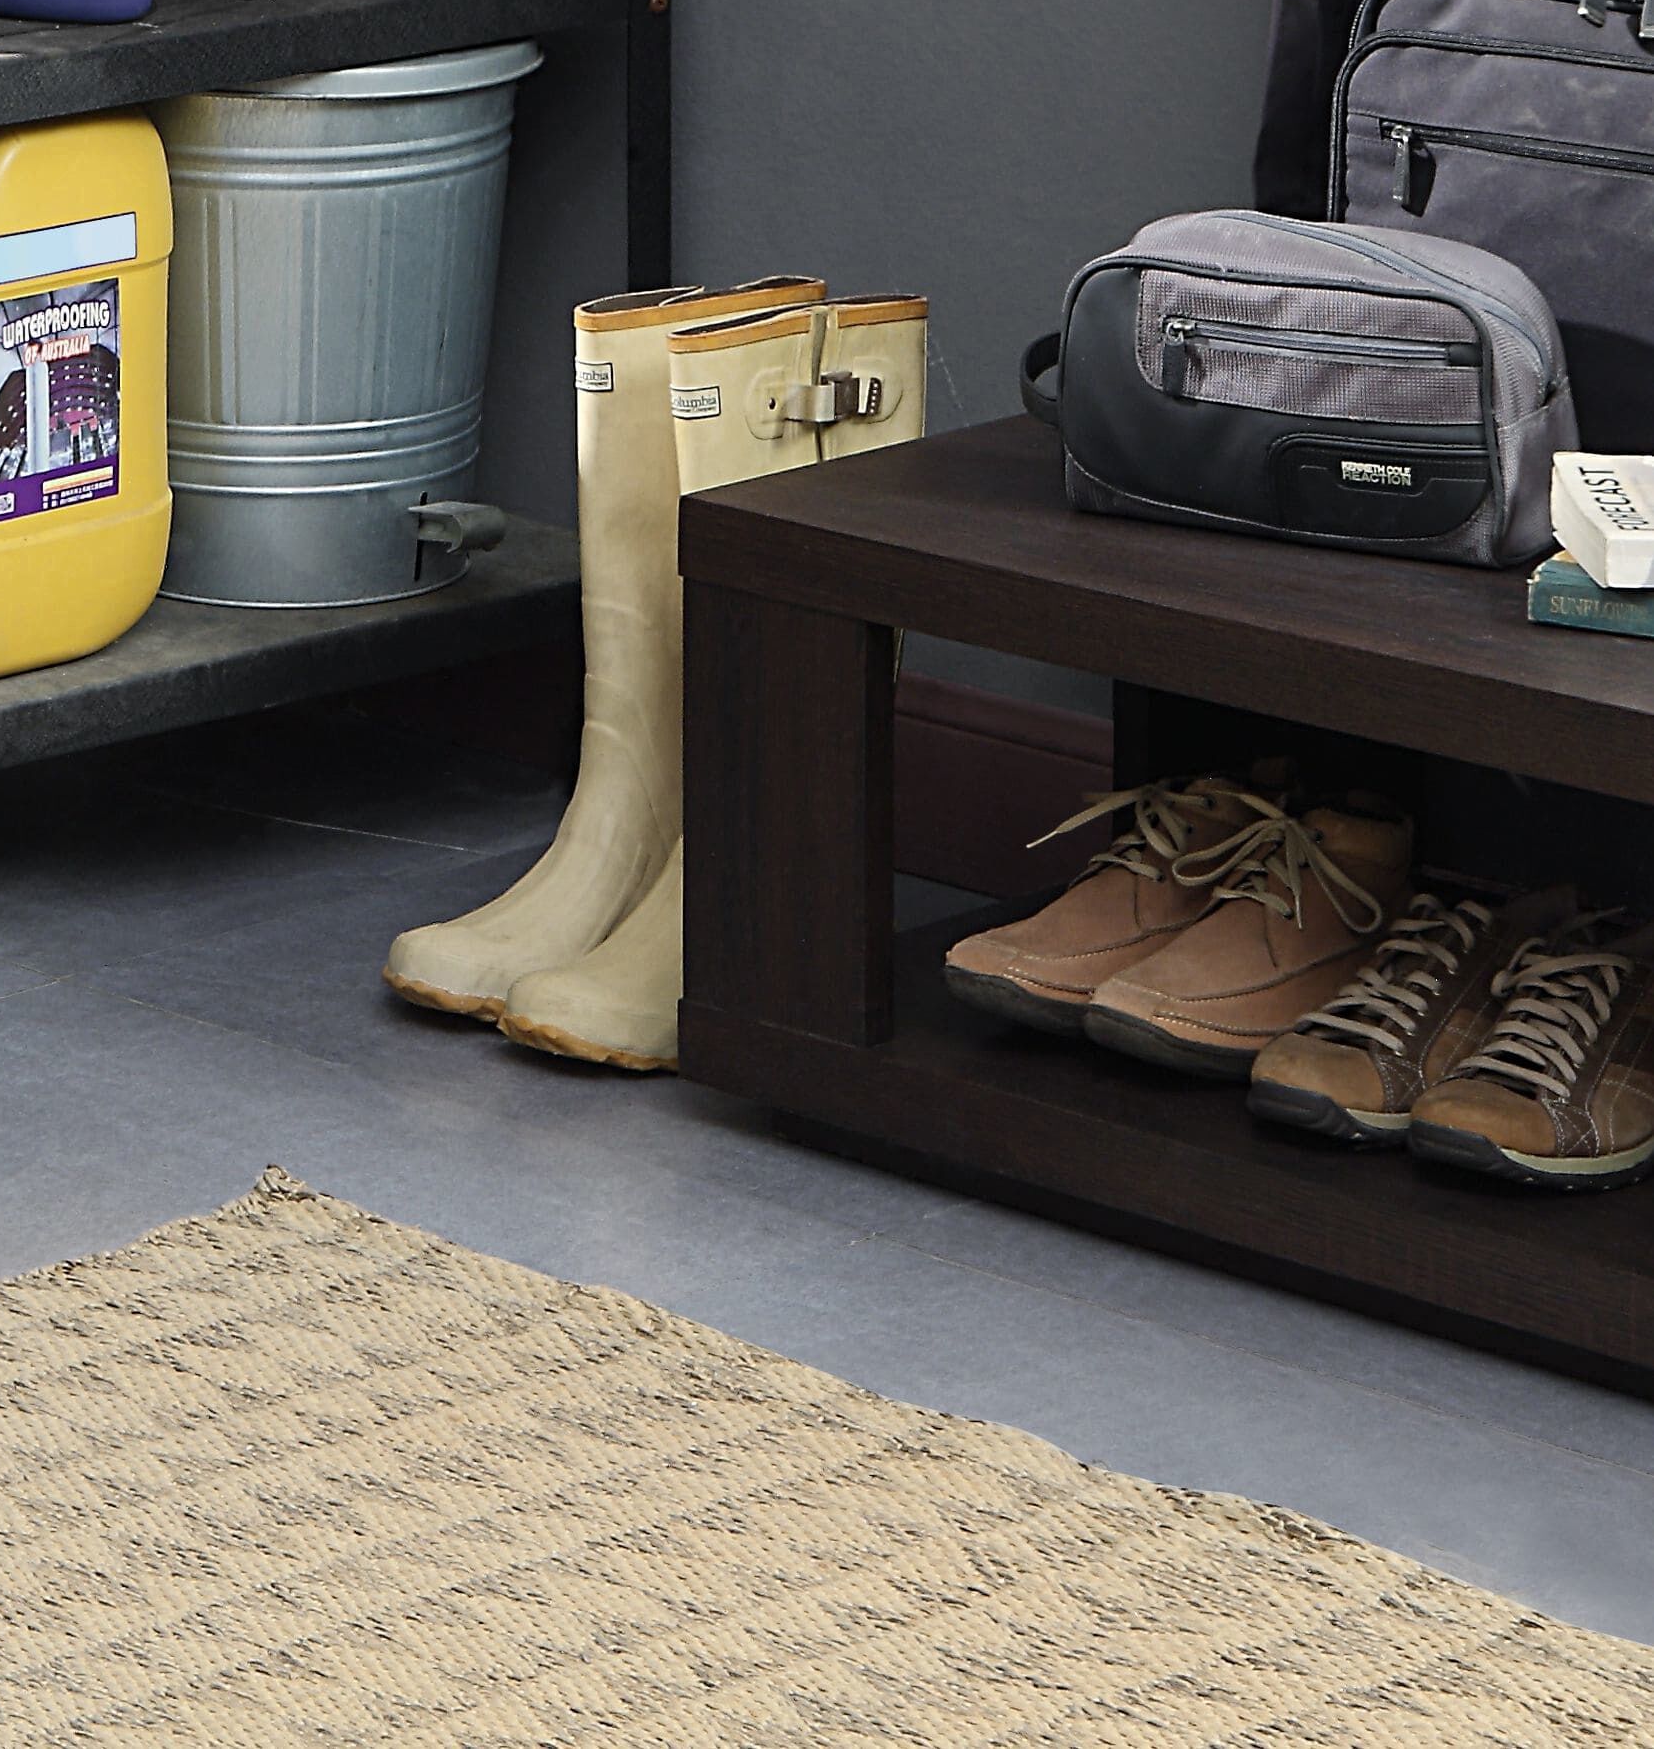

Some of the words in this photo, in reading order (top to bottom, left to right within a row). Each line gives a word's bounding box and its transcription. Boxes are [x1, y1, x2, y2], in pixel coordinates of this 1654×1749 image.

[2, 302, 110, 349] WATERPROOFING
[24, 344, 39, 364] OF
[41, 334, 91, 361] AUSTRALIA
[1342, 470, 1412, 486] REACTION
[1386, 466, 1411, 476] COLE
[1578, 467, 1654, 531] FORECAST
